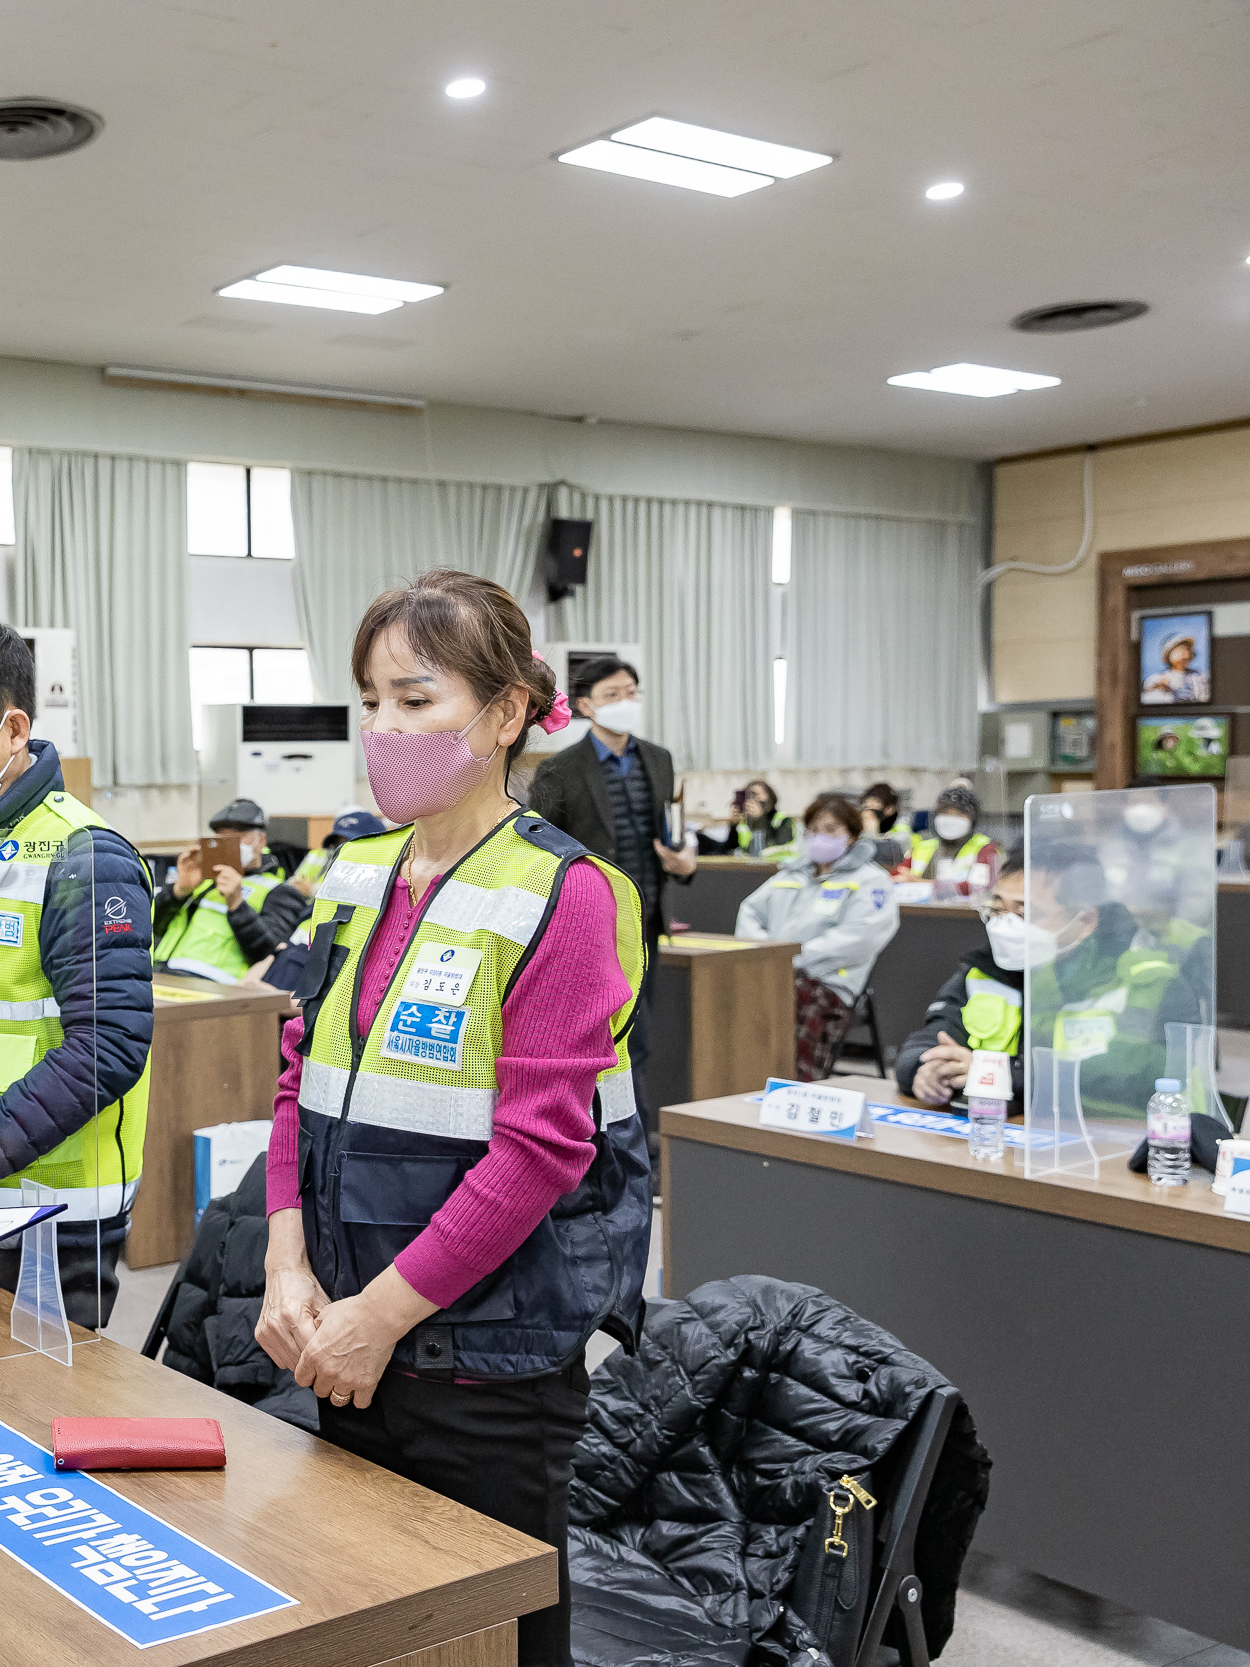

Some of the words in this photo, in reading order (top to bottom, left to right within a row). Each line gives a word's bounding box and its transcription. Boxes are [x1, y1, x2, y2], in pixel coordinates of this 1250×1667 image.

[23, 840, 64, 853] 광진구
[103, 923, 133, 934] PEAK
[397, 1005, 457, 1039] 순찰
[386, 1034, 457, 1063] 서울시자율방범연합회
[71, 1533, 235, 1621] 책임진다
